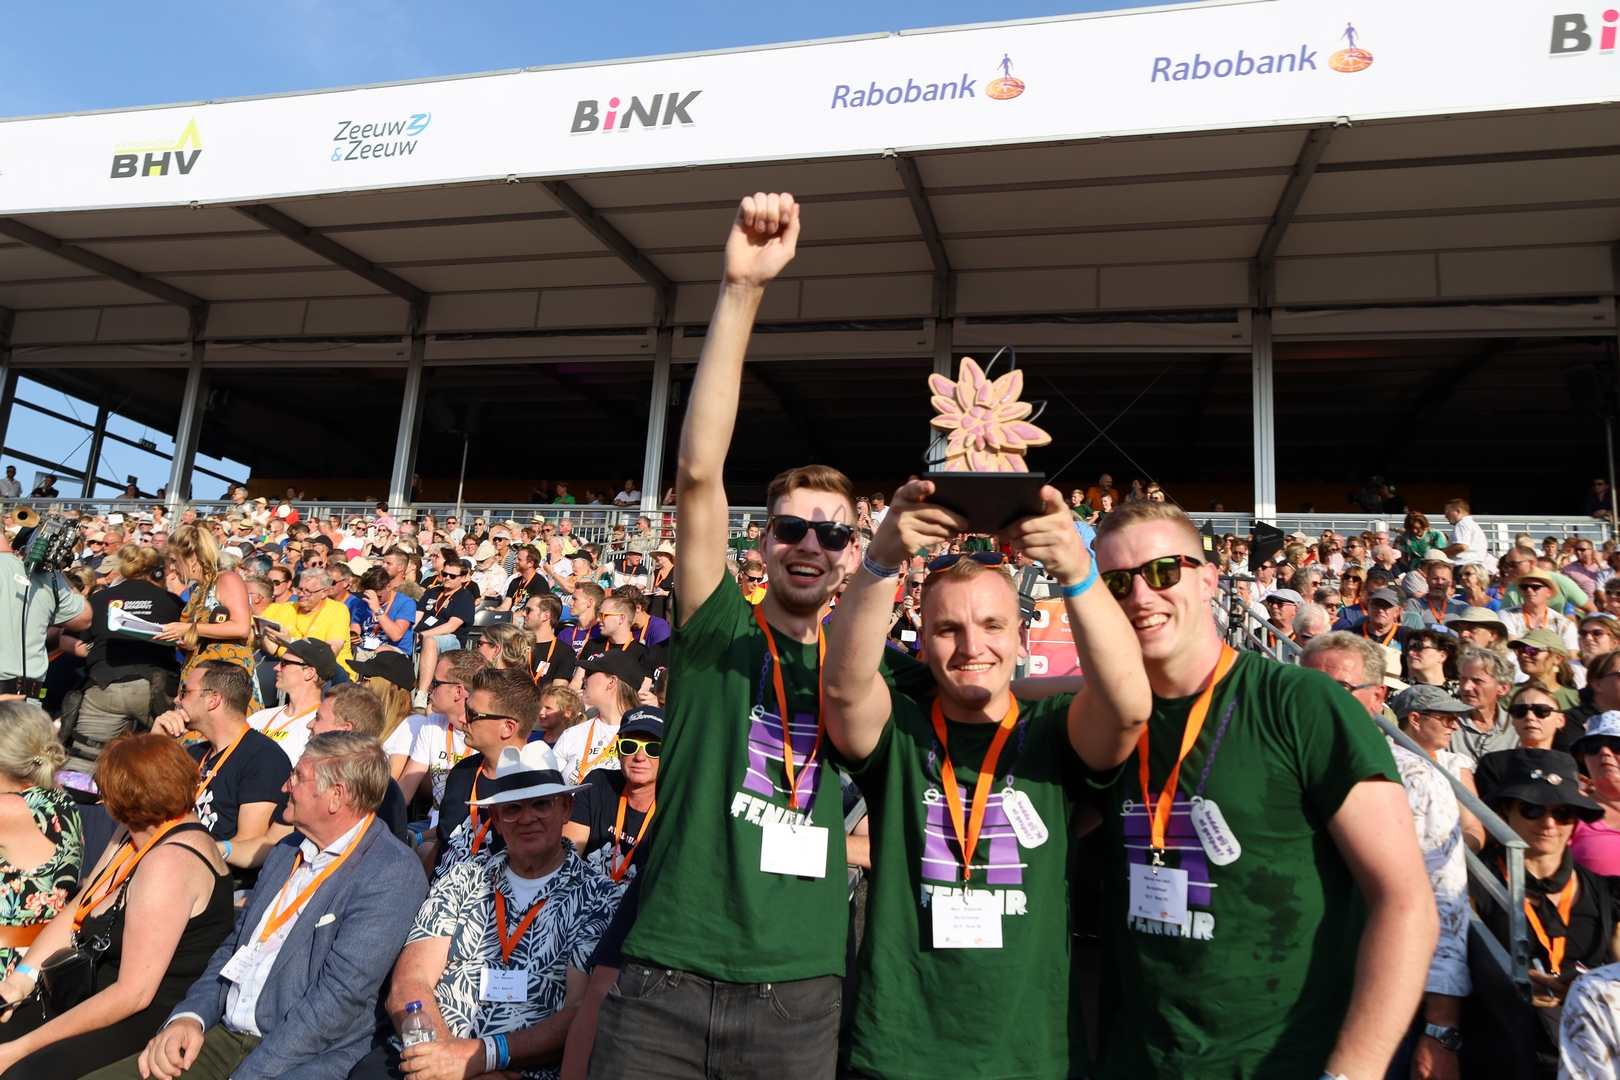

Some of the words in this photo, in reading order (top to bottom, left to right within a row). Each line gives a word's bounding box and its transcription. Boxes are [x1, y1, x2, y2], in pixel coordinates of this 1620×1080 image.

[1151, 44, 1318, 83] Rabobank
[831, 73, 977, 109] Rabobank
[115, 139, 176, 149] EXPOGROEP
[333, 120, 406, 141] Zeeuw
[110, 149, 202, 179] BHV
